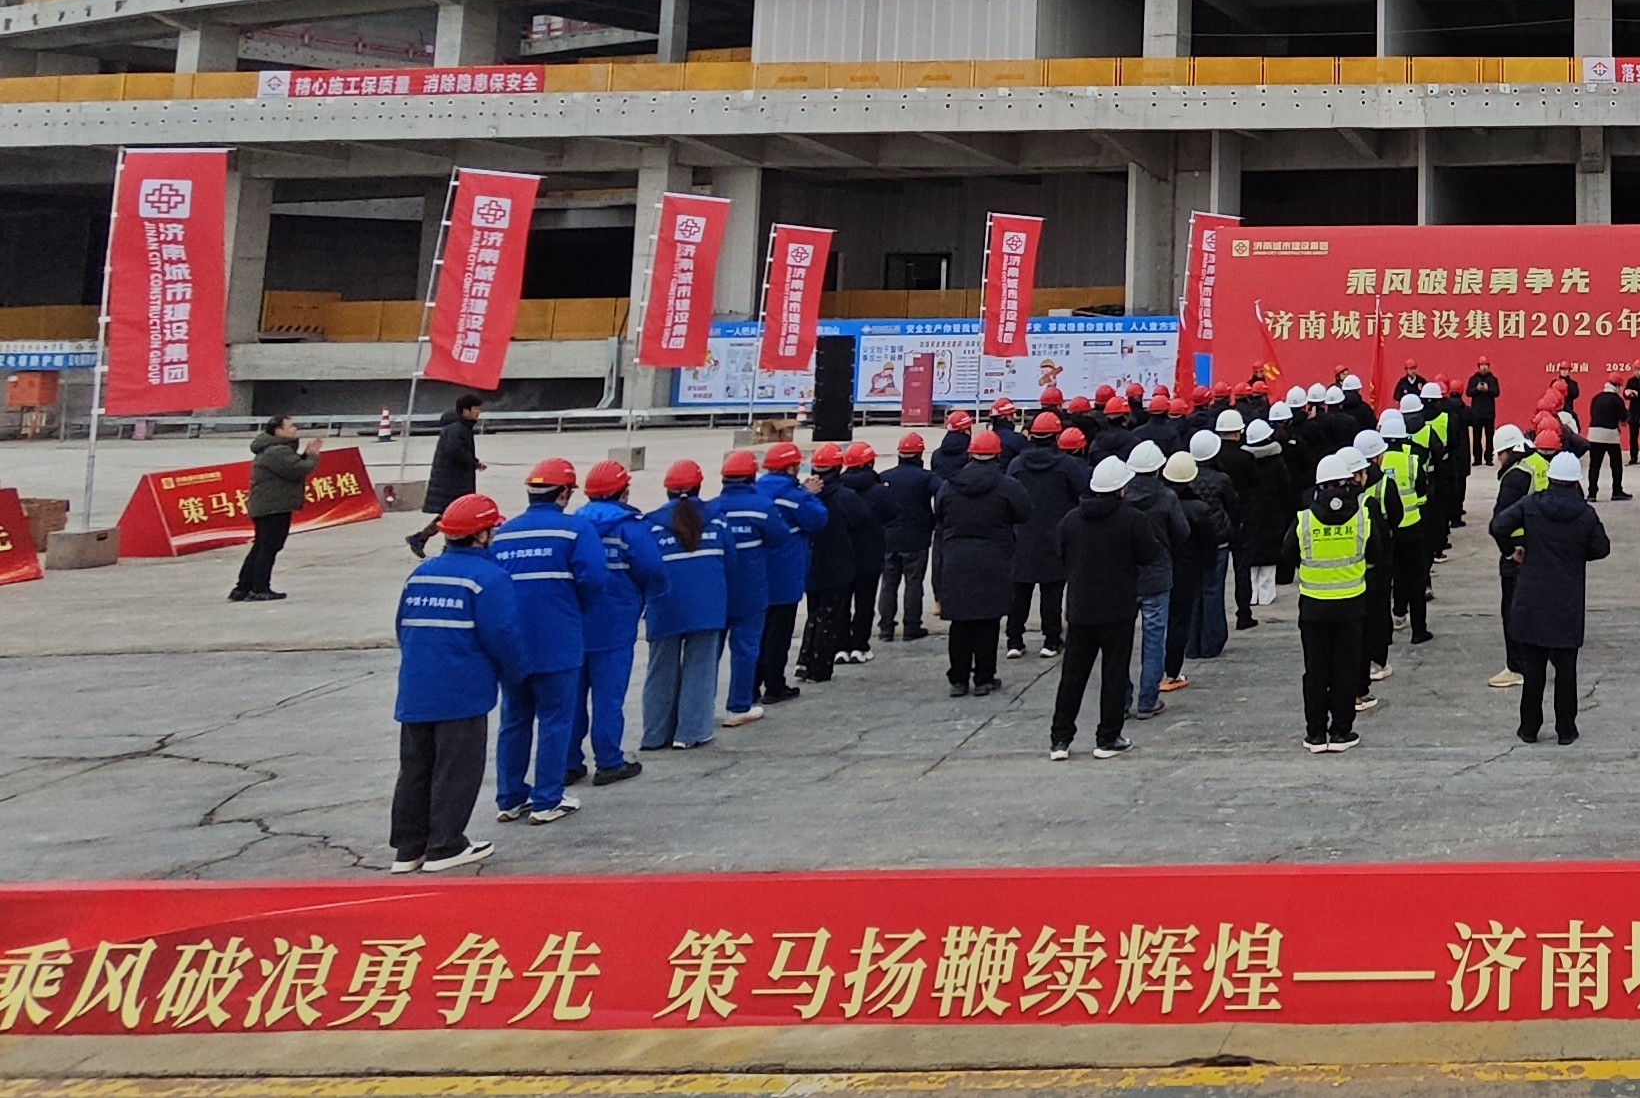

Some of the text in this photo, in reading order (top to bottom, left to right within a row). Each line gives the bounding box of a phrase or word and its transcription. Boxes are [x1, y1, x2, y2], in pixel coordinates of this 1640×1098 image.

[295, 71, 539, 96] 精心施工保质量 消除隐患保安全
[144, 221, 159, 250] JINAN
[149, 252, 162, 272] CITY
[1346, 268, 1590, 295] 乘风破浪勇争先
[149, 273, 163, 348] CONSTRUCTION
[158, 222, 193, 385] 济南城市建设集团
[460, 230, 504, 363] 济南城市建设集团
[0, 932, 601, 1030] 乘风破浪勇争先
